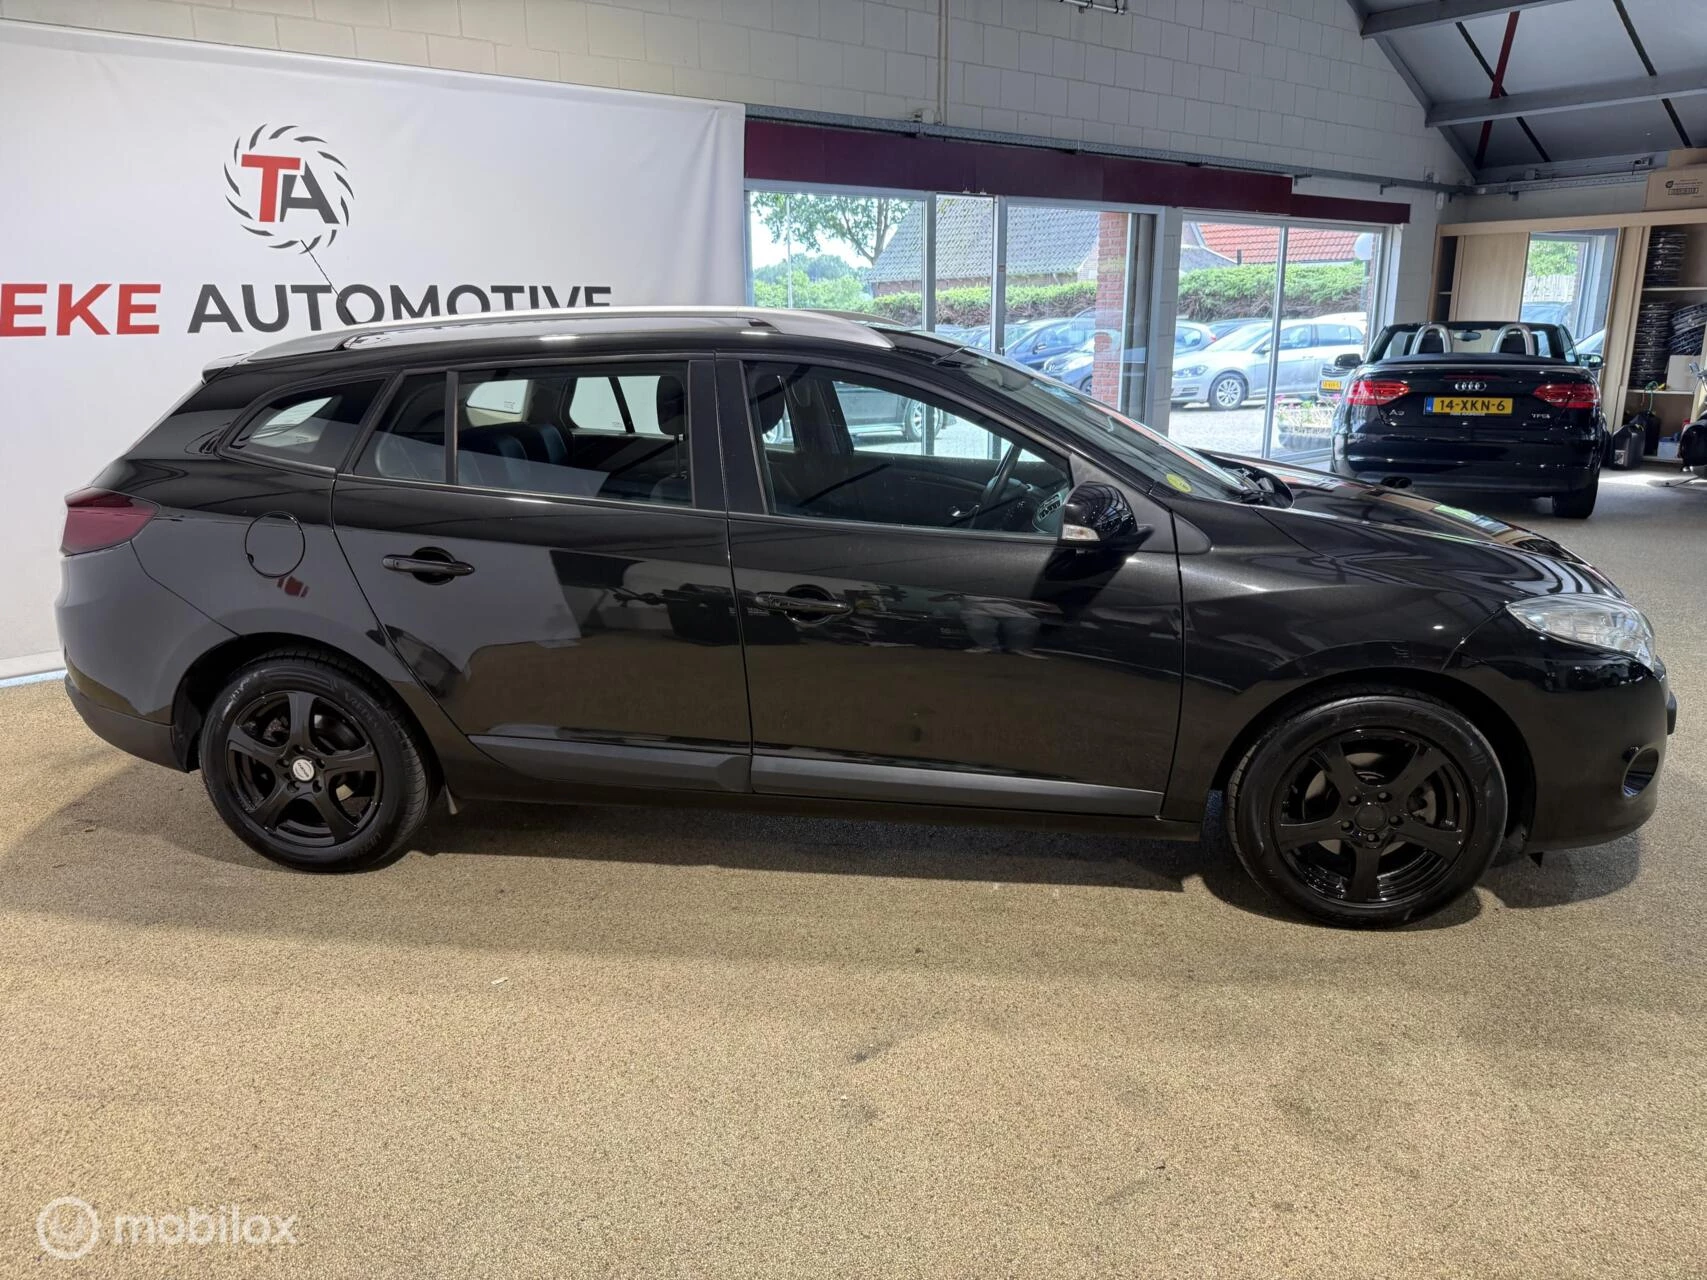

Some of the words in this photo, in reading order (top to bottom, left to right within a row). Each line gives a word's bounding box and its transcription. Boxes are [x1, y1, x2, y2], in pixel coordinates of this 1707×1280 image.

[241, 154, 340, 224] TA
[0, 283, 161, 337] EKE
[1440, 399, 1506, 411] 14-XKN-6
